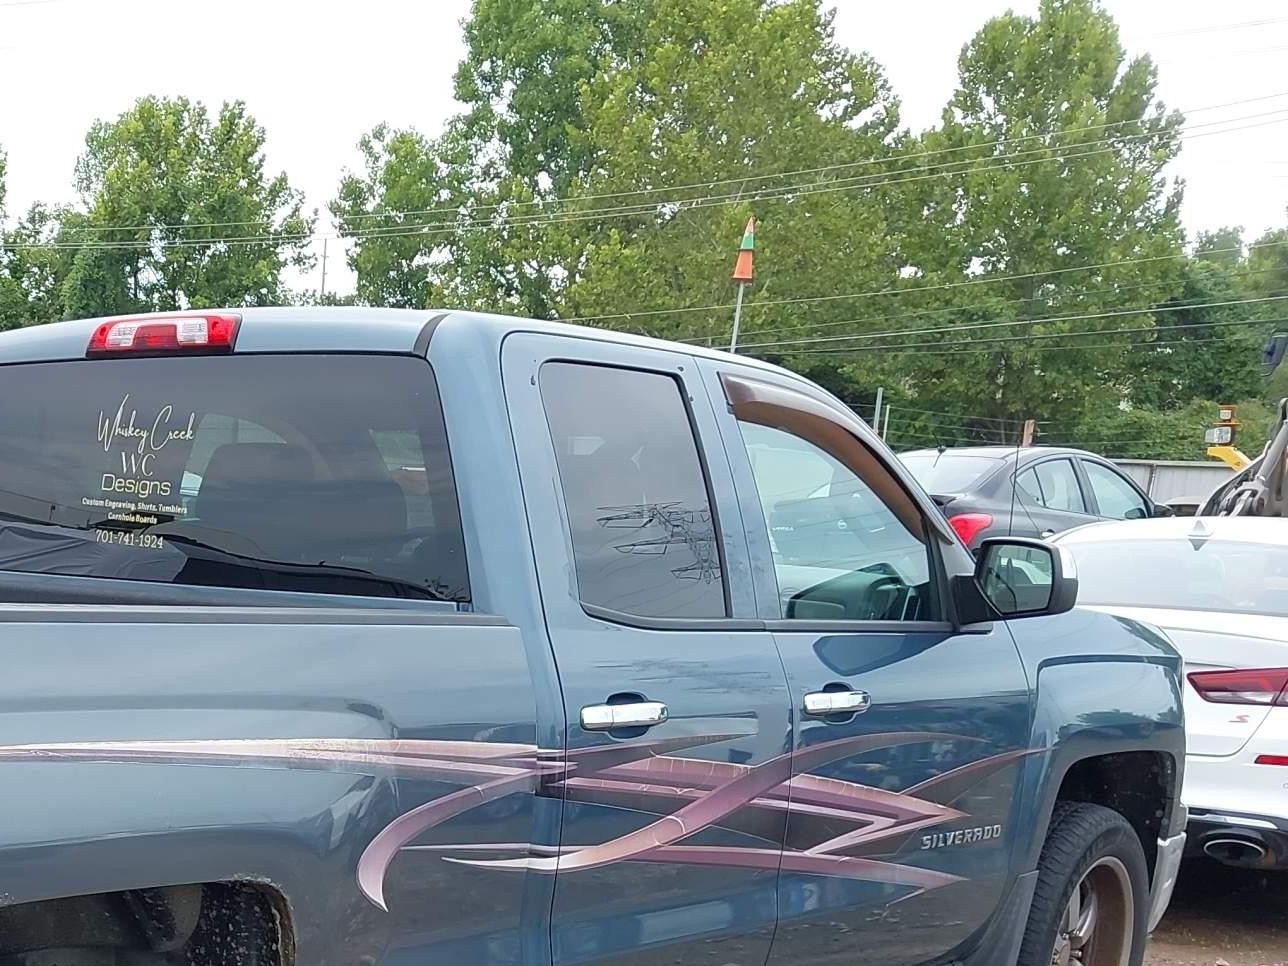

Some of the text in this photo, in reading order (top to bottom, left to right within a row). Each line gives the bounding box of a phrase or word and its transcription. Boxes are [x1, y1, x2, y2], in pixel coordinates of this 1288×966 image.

[97, 393, 196, 454] Whiskey Creek
[120, 451, 156, 477] WC
[100, 473, 172, 498] Designs
[82, 497, 105, 507] Custom
[158, 503, 188, 514] Tumblers
[108, 511, 158, 525] Cornhole Boards
[95, 529, 164, 549] 701-741-1924
[920, 824, 1002, 850] SILVERADO
